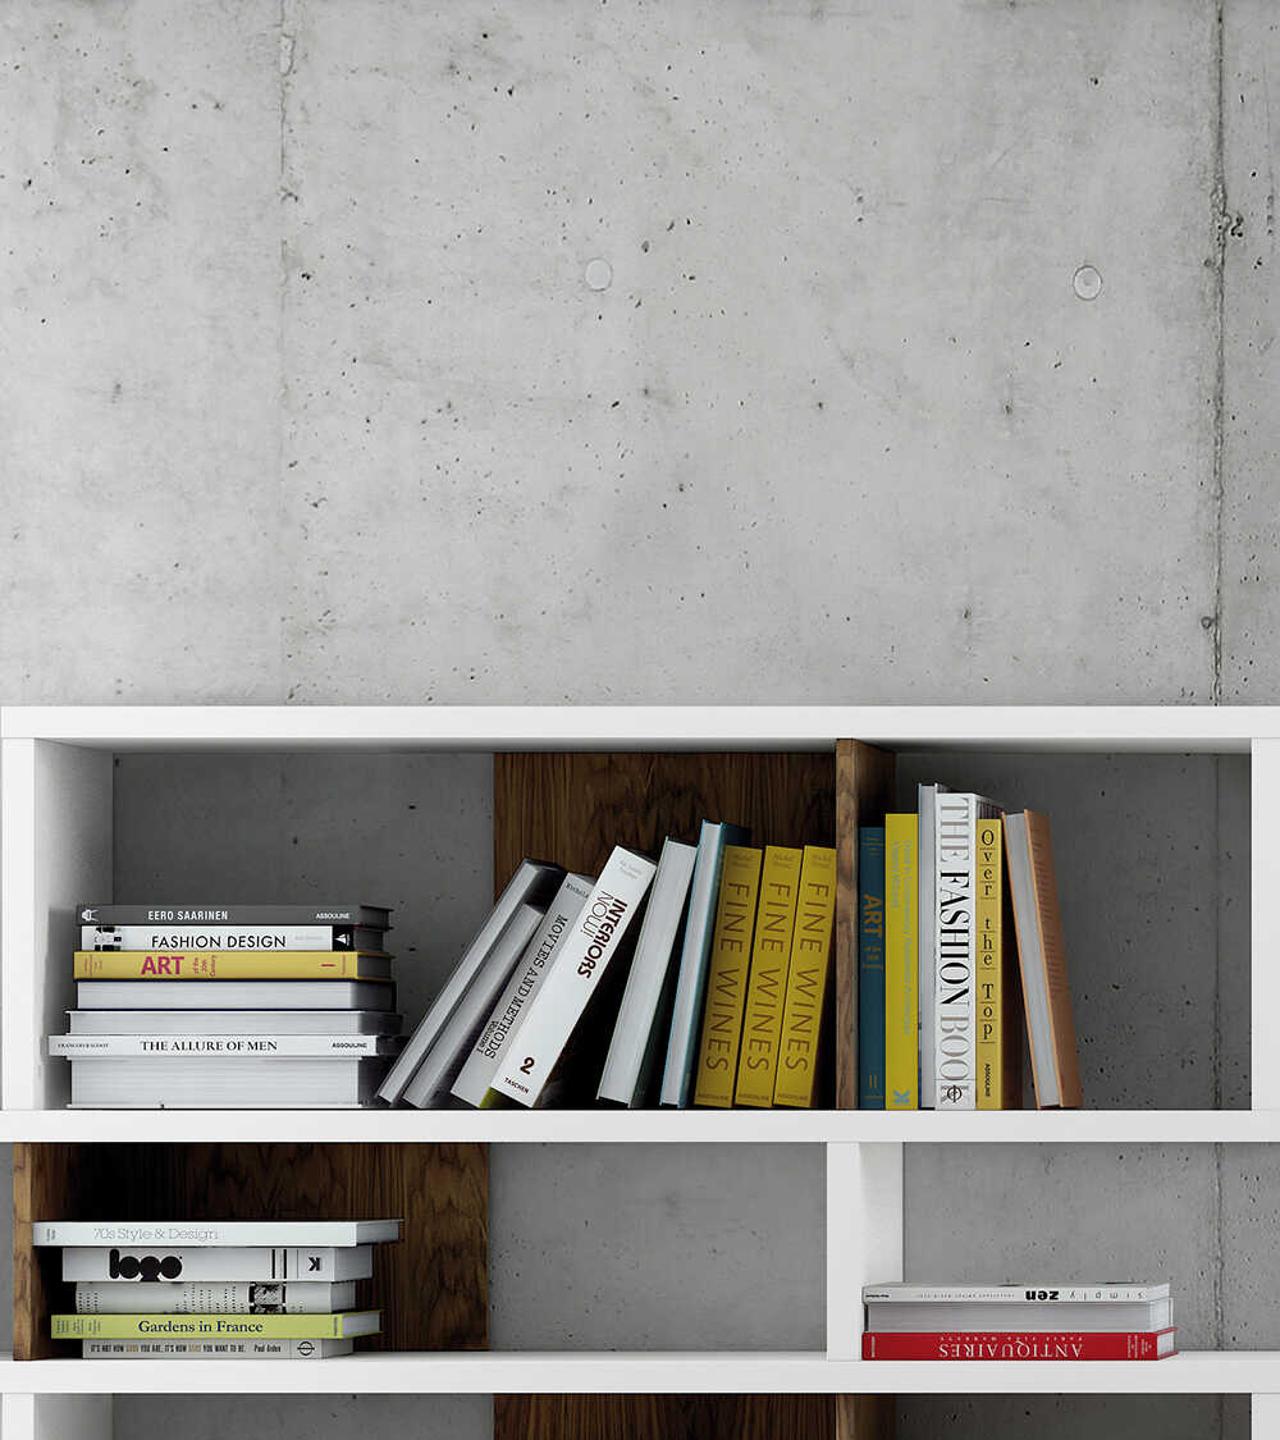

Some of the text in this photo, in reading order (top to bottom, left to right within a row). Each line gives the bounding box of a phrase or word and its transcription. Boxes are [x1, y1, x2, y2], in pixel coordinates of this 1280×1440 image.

[939, 796, 970, 863] THE
[147, 910, 229, 921] EERO SAARINEN
[150, 935, 222, 948] FASHION
[226, 935, 287, 948] DESIGN
[577, 897, 627, 979] INTERIORS
[719, 881, 750, 954] FINE
[760, 881, 790, 954] FINE
[798, 881, 830, 954] FINE
[864, 894, 883, 940] ART
[939, 871, 970, 1006] FASHION
[981, 829, 996, 1042] Over the Top
[139, 955, 185, 975] ART
[482, 914, 568, 1059] MOVIES AND METHODS
[139, 1040, 278, 1053] THE ALLURE OF MEN
[706, 966, 739, 1072] WINES
[747, 966, 781, 1072] WINES
[785, 966, 819, 1072] WINES
[519, 1056, 536, 1076] 2
[108, 1248, 183, 1282] logo
[1025, 1289, 1060, 1301] zen
[138, 1319, 264, 1333] Gardens in France
[938, 1340, 1083, 1359] ANTIQUAIRES
